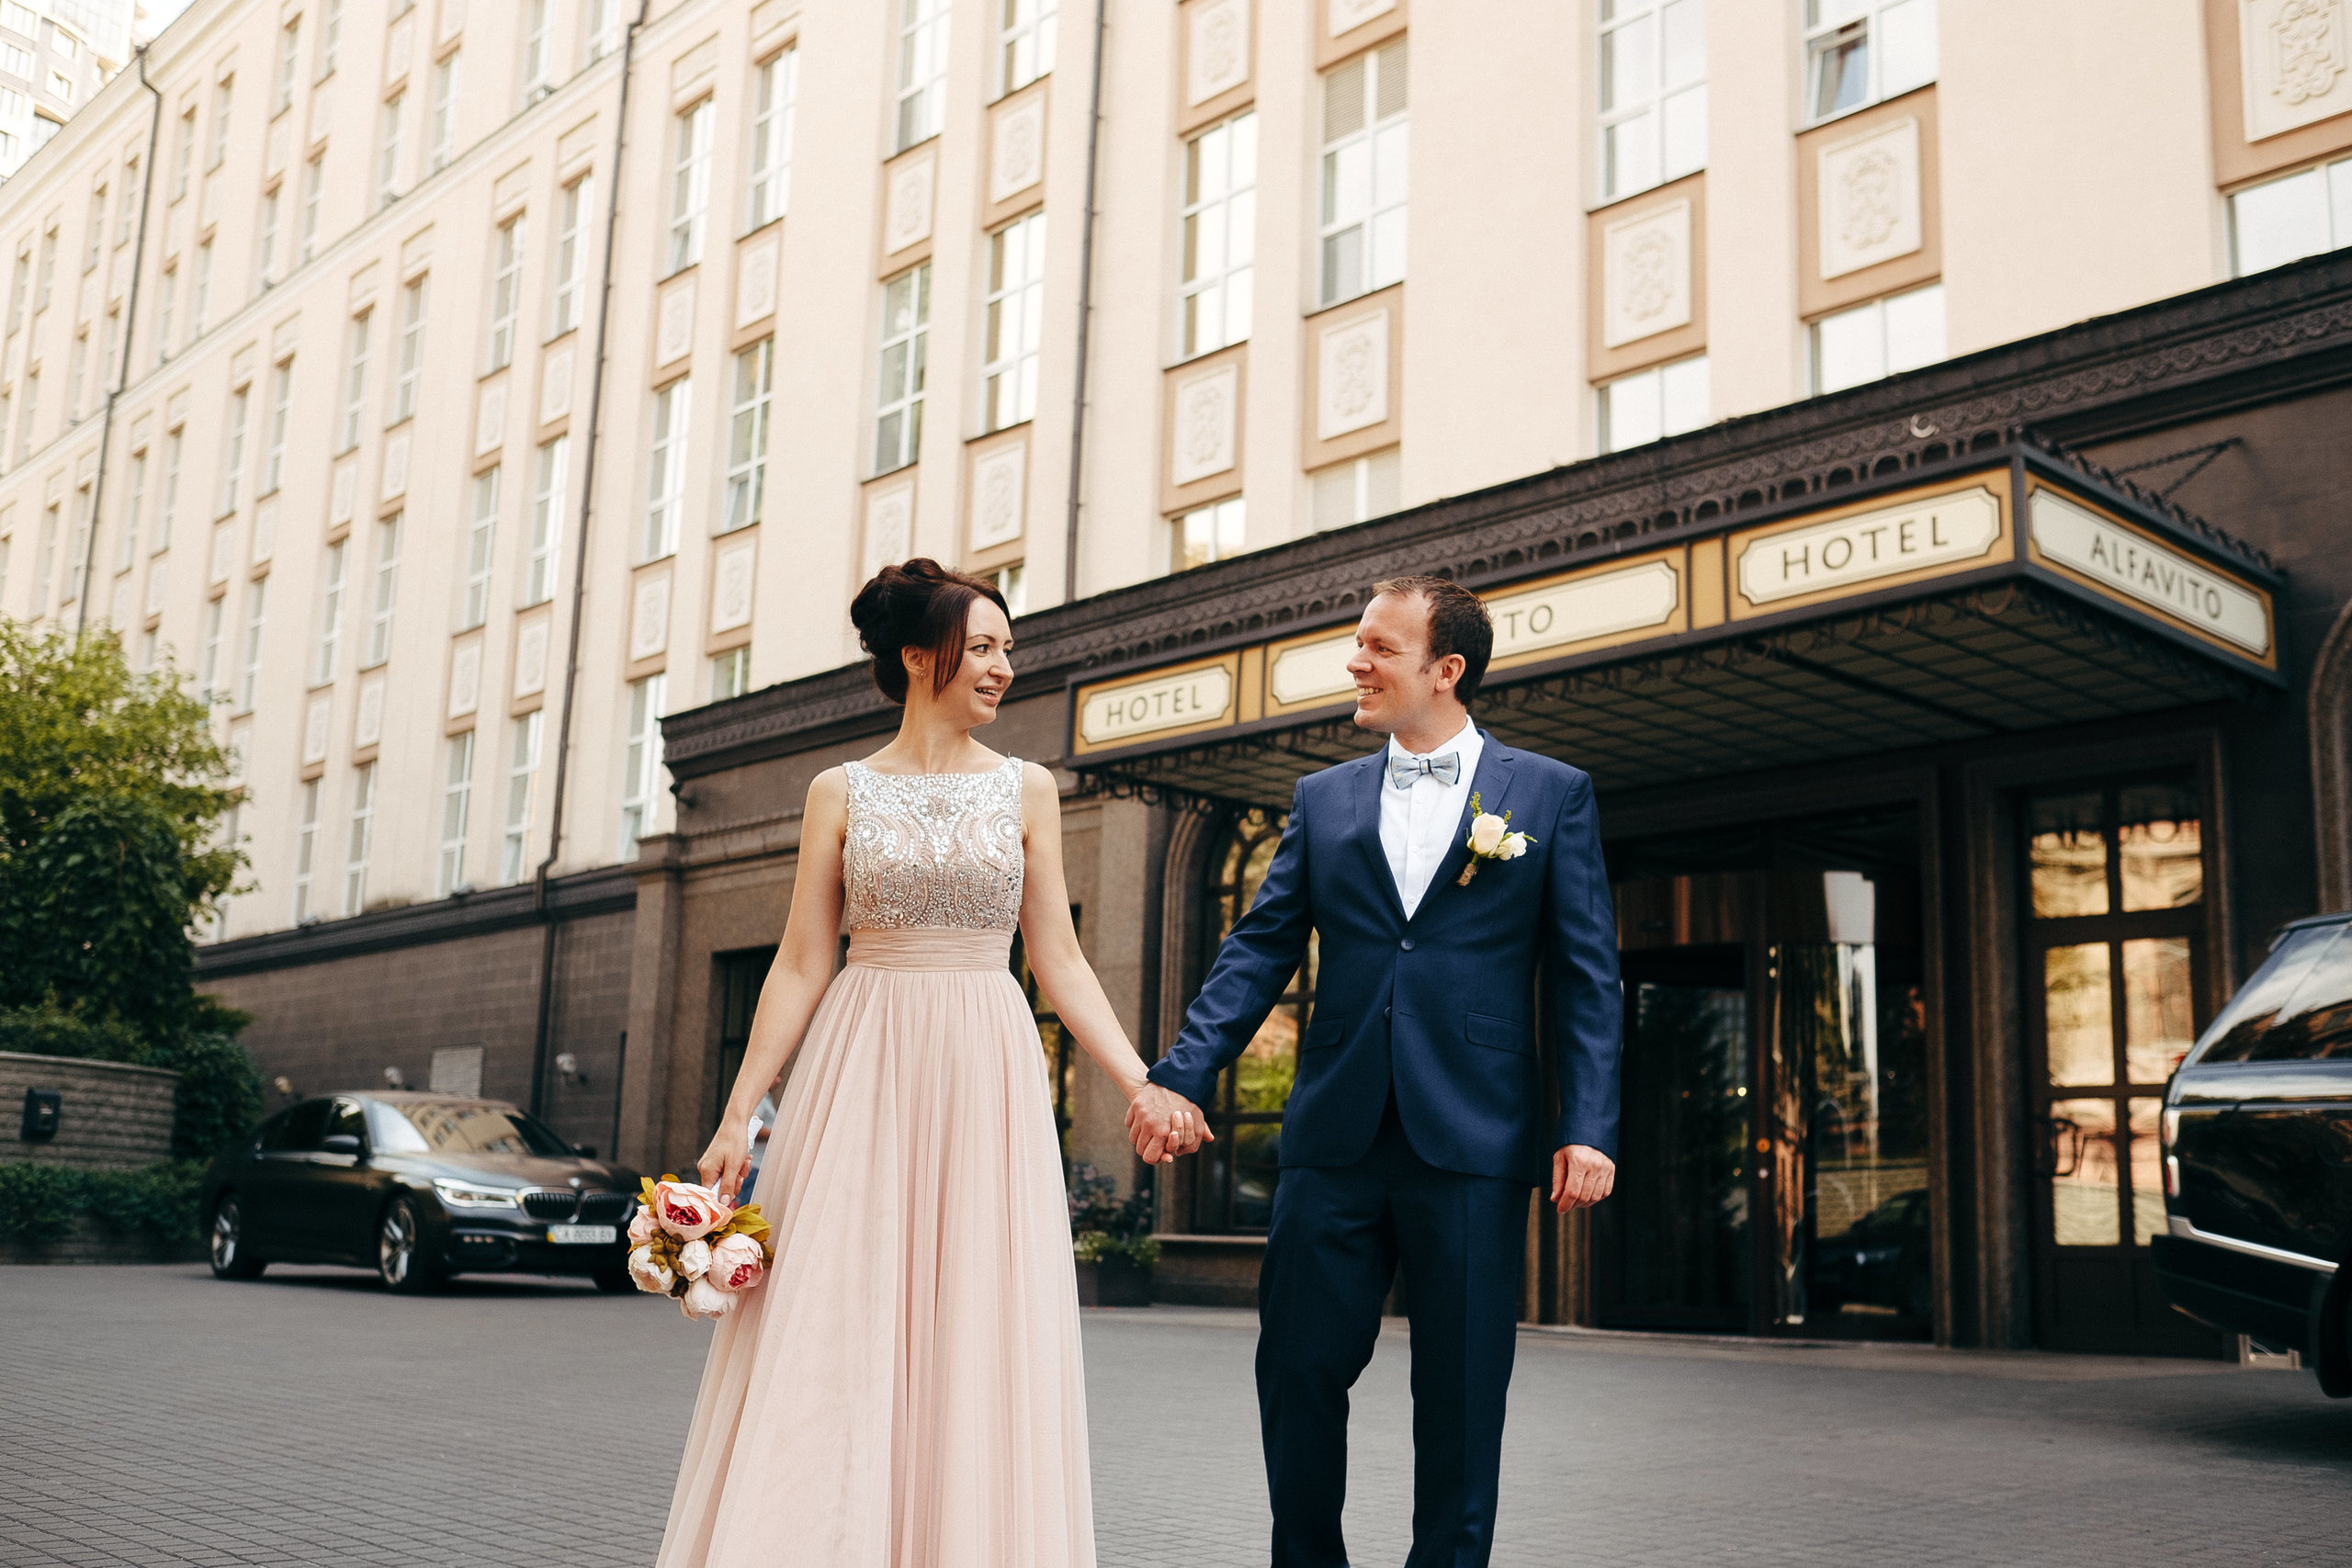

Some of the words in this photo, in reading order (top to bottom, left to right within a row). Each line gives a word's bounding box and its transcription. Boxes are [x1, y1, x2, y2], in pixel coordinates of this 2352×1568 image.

[1782, 516, 1949, 580] HOTEL
[2089, 533, 2222, 619] ALFAVITO
[1106, 684, 1203, 728] HOTEL
